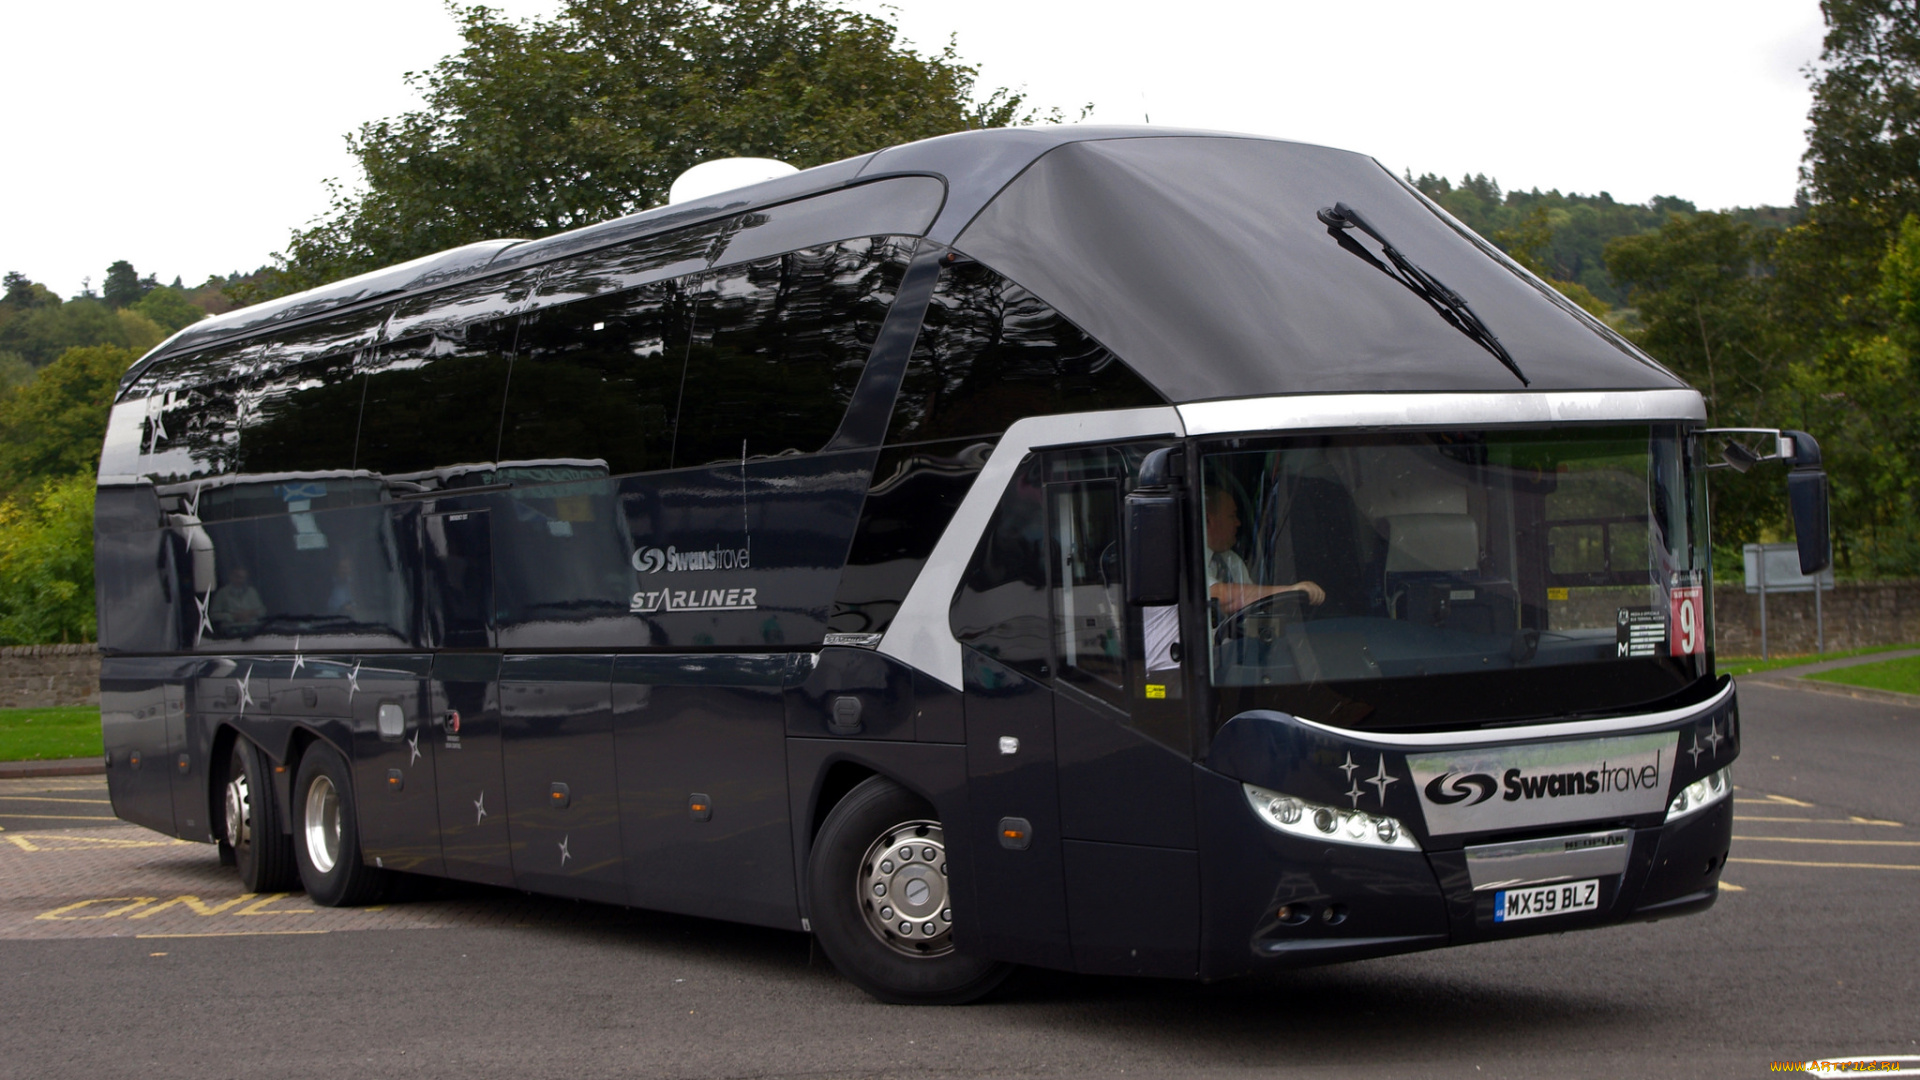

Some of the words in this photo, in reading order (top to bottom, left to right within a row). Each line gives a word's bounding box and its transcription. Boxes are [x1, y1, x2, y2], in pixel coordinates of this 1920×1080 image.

[630, 587, 757, 612] STARLINER
[1680, 599, 1695, 654] 9
[1618, 642, 1628, 657] M
[1503, 749, 1660, 801] Swanstravel
[1565, 834, 1625, 851] NEOPLAN
[34, 892, 386, 920] ONL
[1507, 889, 1556, 916] MX59
[1561, 884, 1596, 909] BLZ
